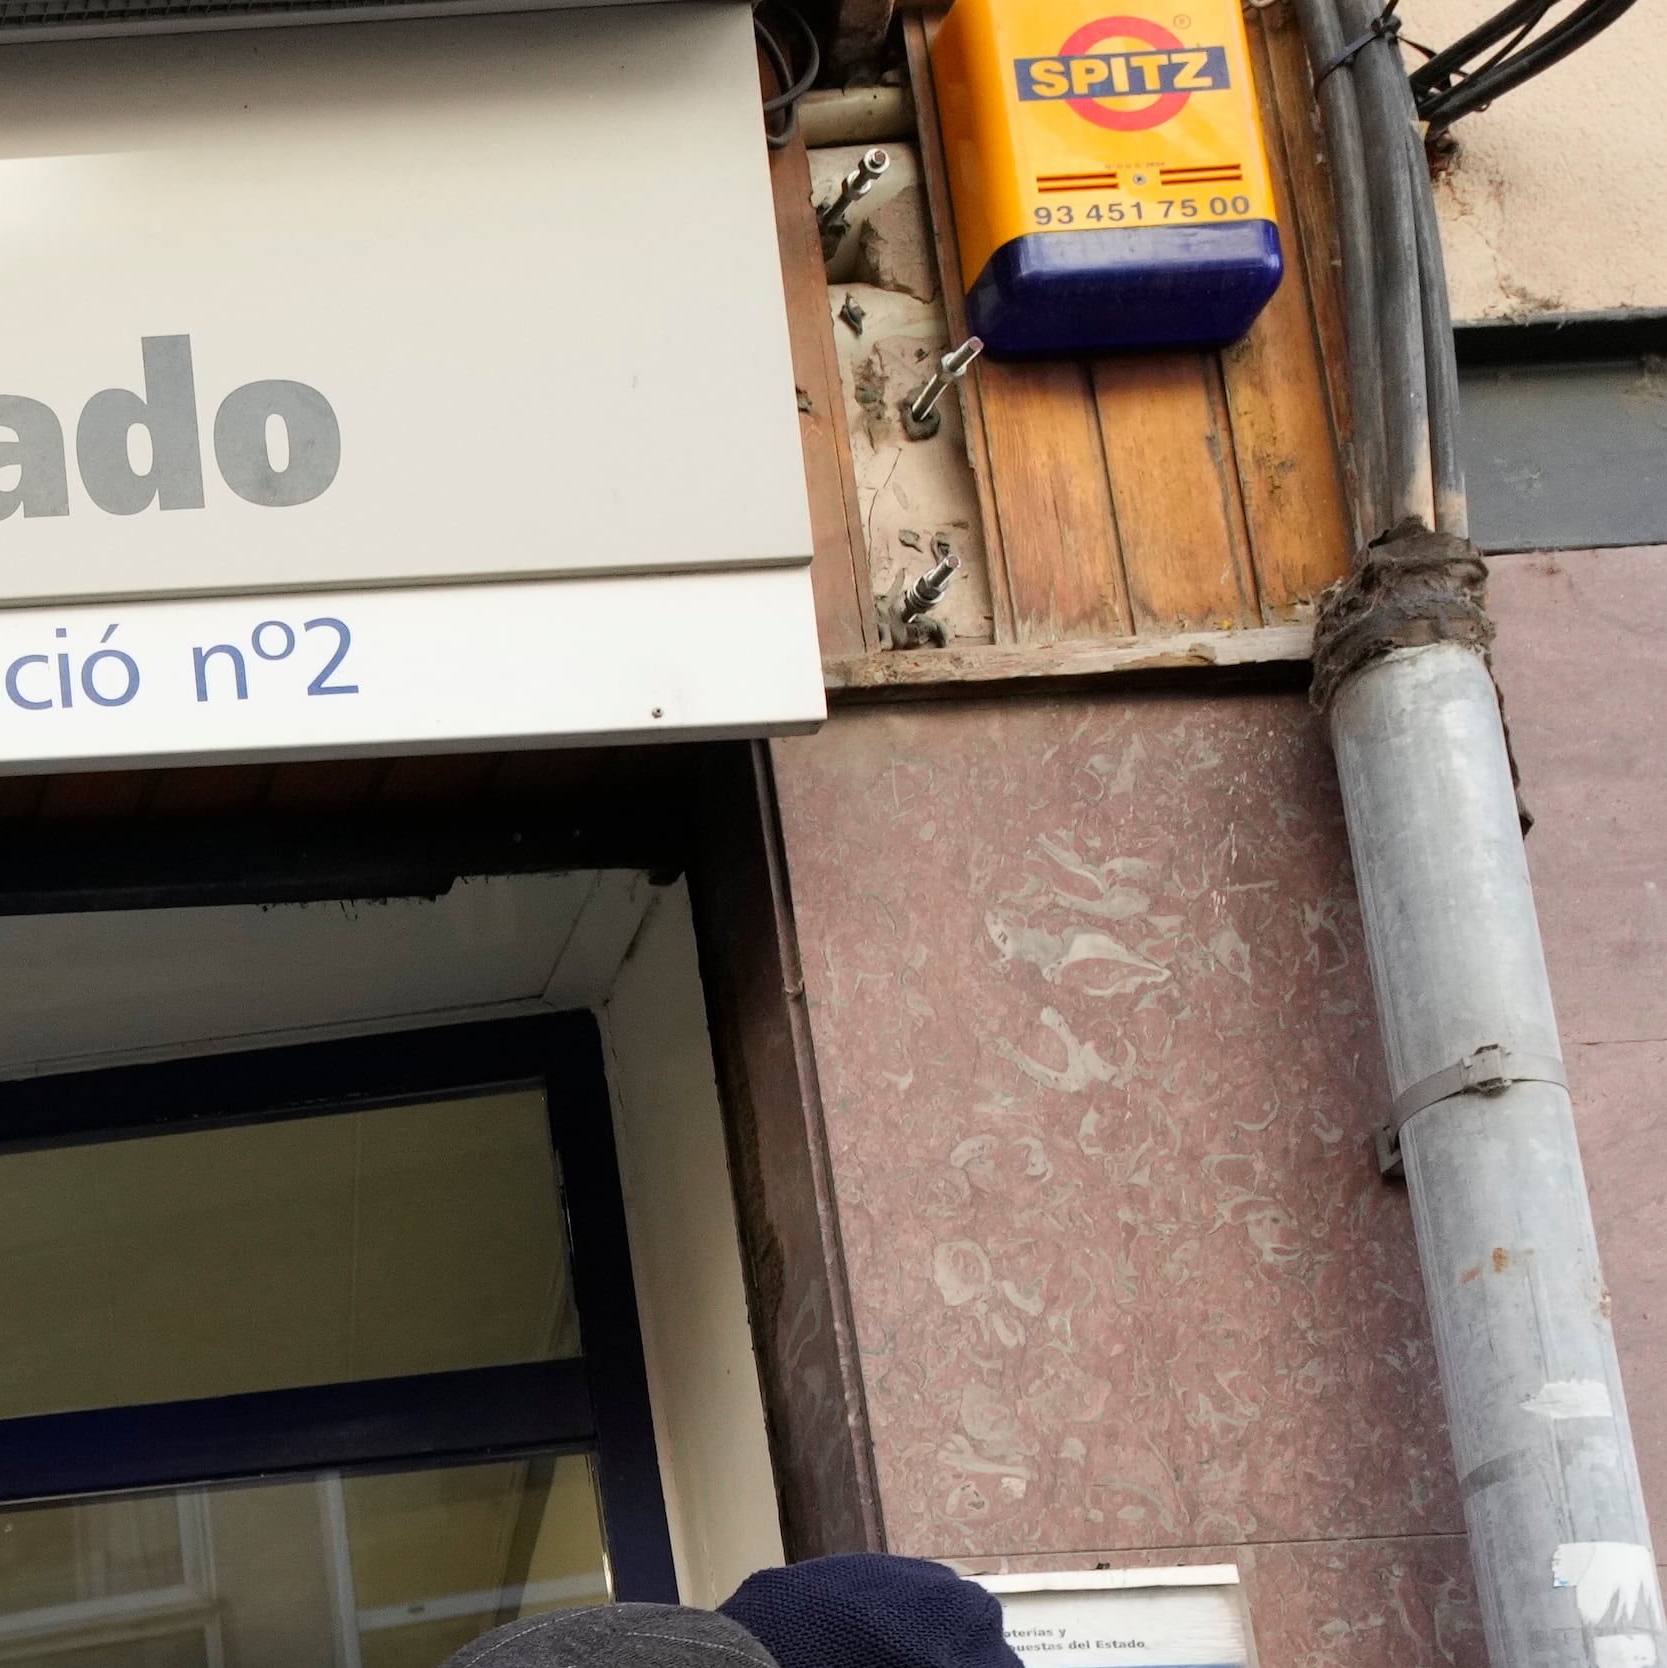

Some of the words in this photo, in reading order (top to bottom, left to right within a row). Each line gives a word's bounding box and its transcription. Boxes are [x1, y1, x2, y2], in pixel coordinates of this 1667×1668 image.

[1029, 52, 1212, 97] SPITZ
[1034, 206, 1074, 226] 93
[1086, 202, 1144, 223] 451
[1157, 199, 1198, 218] 75
[1210, 196, 1250, 215] 00
[1059, 1627, 1067, 1639] y
[1068, 1638, 1090, 1650] del
[1095, 1638, 1146, 1650] Estado
